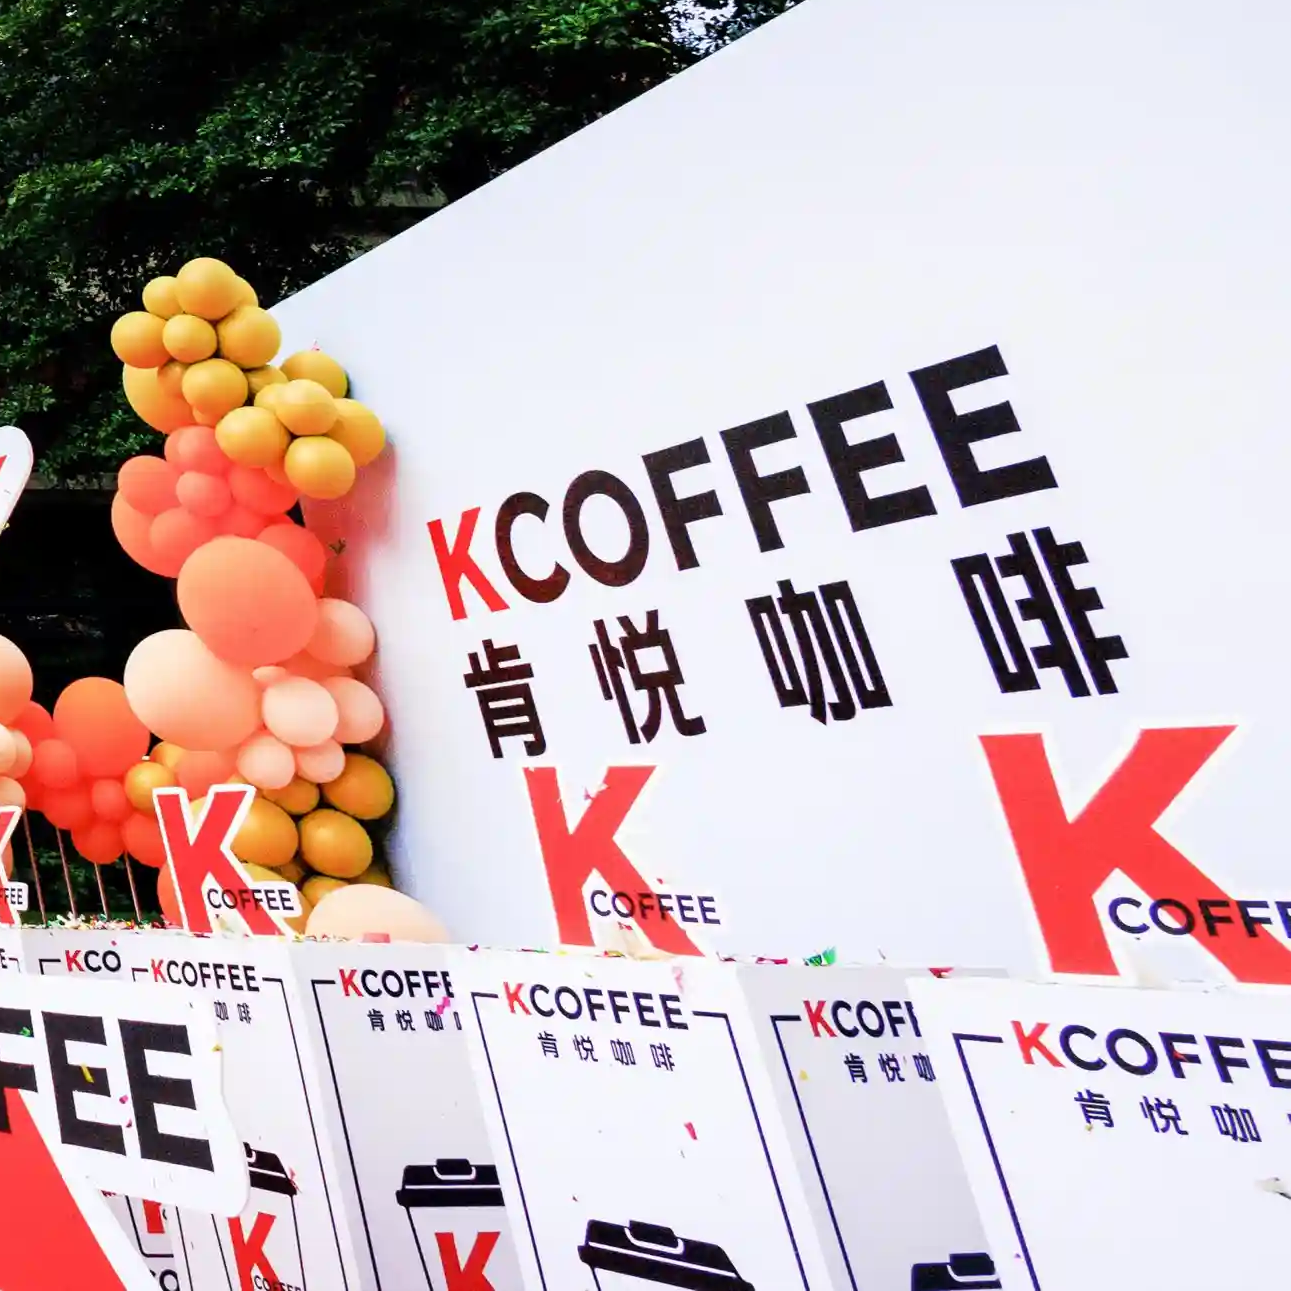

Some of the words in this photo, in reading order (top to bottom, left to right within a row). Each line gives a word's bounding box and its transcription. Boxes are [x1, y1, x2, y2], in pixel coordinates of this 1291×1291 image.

[427, 344, 1059, 621] KCOFFEE
[464, 525, 1130, 760] 肯悦咖啡
[206, 887, 295, 912] COFFEE
[589, 889, 722, 926] COFFEE
[150, 958, 261, 993] KCOFFEE
[502, 981, 689, 1031] KCOFFEE
[537, 1030, 677, 1072] 肯悦咖啡
